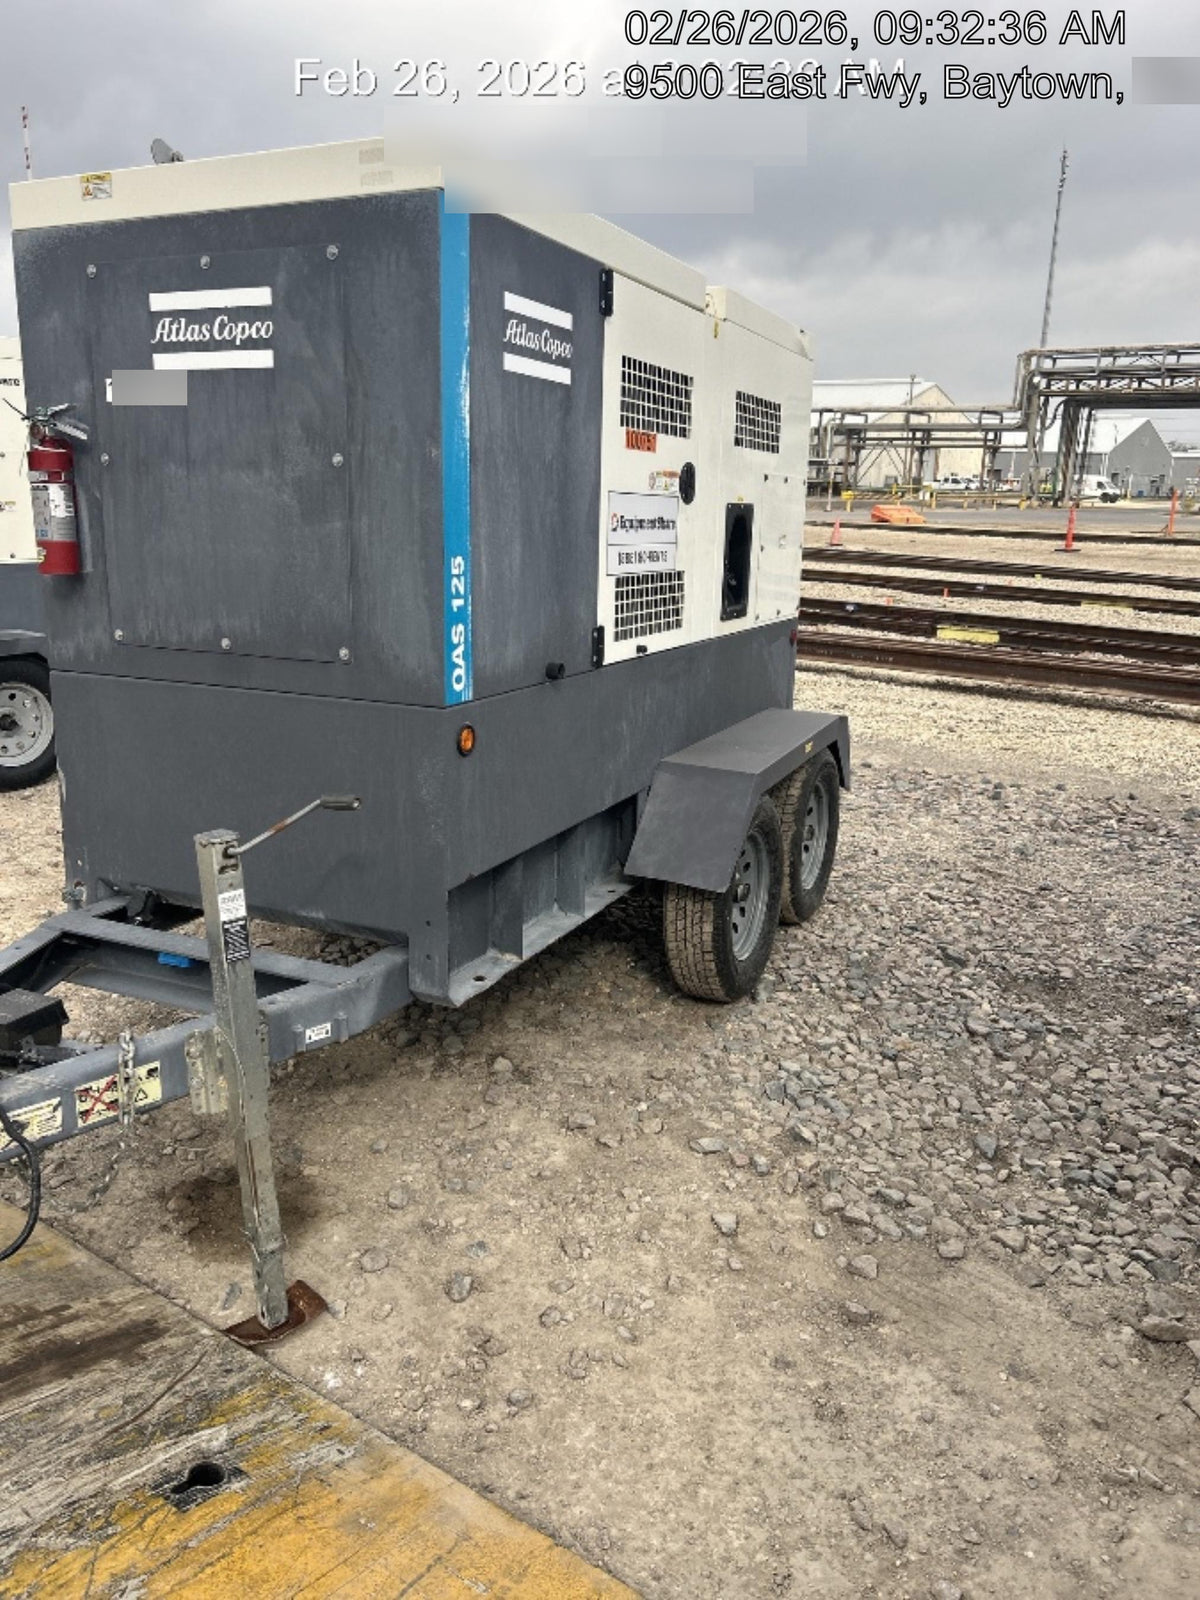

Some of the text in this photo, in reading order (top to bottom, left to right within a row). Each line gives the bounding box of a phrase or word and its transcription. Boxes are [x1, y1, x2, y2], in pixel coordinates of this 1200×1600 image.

[150, 314, 274, 346] Atlas Copco
[503, 319, 574, 360] Atlas Copco
[451, 555, 465, 613] 125
